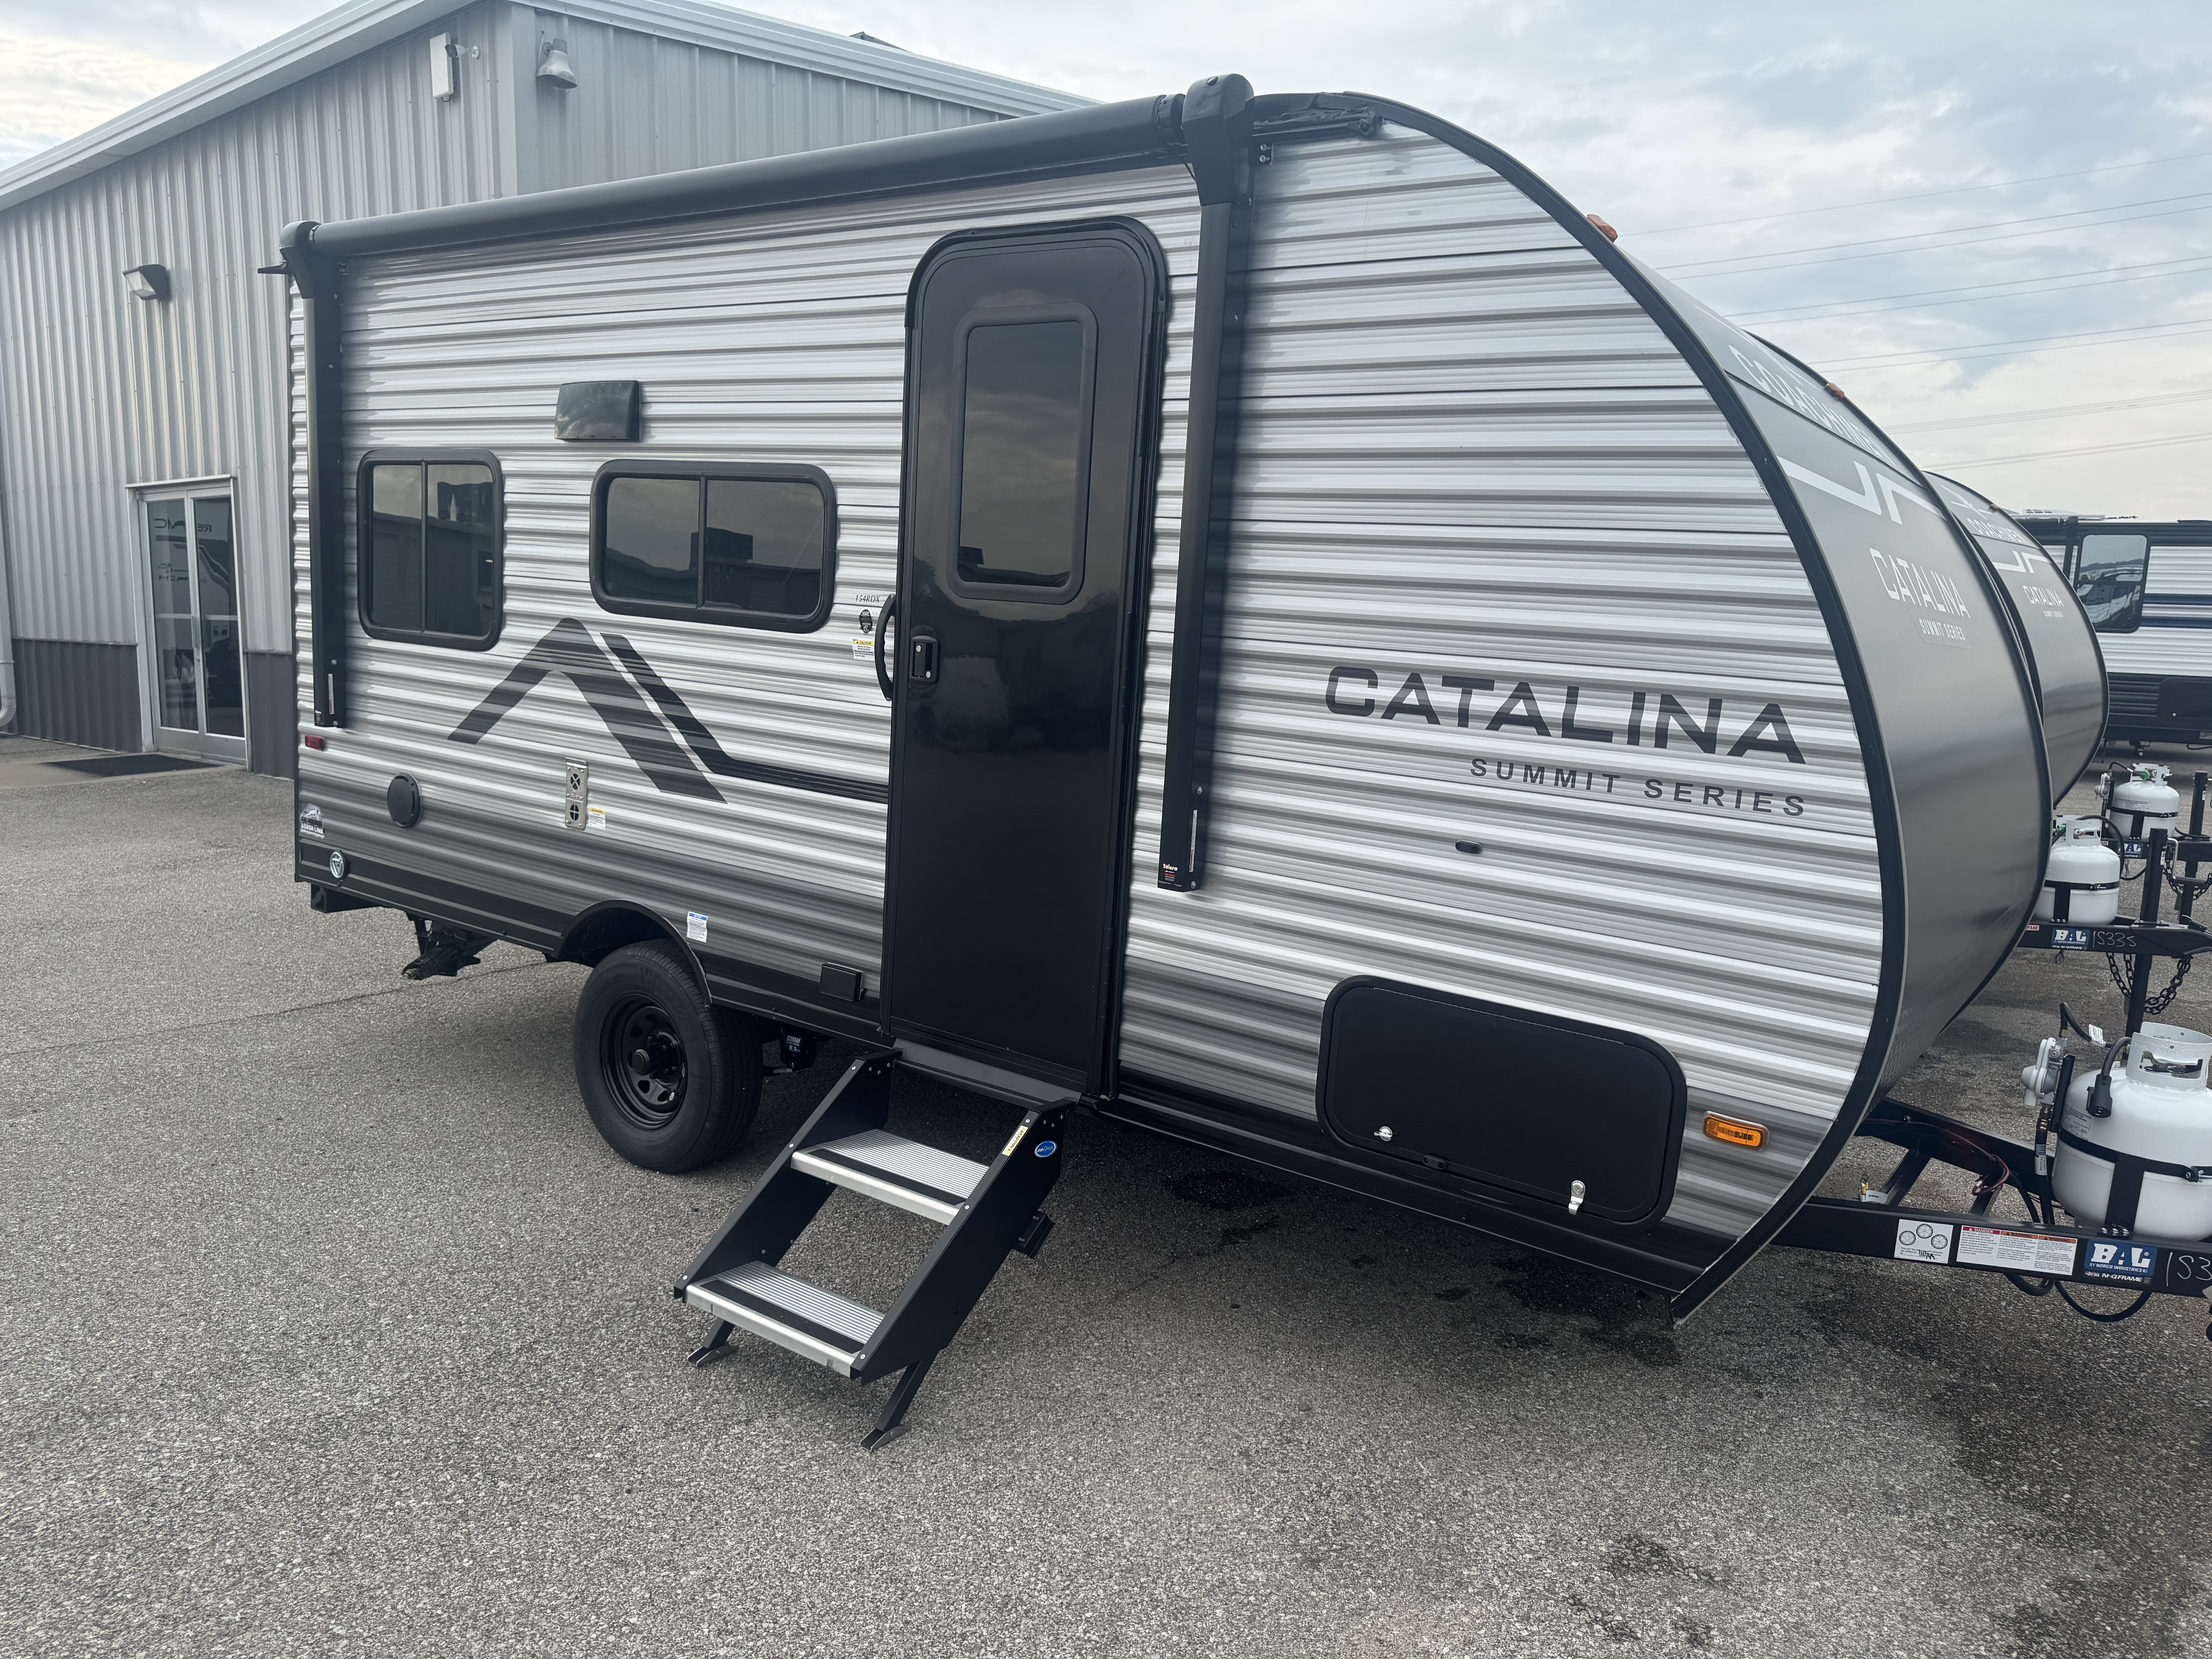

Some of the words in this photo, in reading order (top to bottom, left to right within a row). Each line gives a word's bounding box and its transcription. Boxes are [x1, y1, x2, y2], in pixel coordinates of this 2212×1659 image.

[1869, 548, 1971, 619] CATALINA
[2023, 585, 2064, 606] CATALINA
[1919, 618, 1944, 637] SUMMIT
[1944, 623, 1965, 641] SERIES
[1325, 666, 1806, 765] CATALINA
[1470, 757, 1621, 793] SUMMIT
[1644, 778, 1805, 816] SERIES
[2054, 929, 2087, 942] BAL
[2091, 1243, 2150, 1268] BAL
